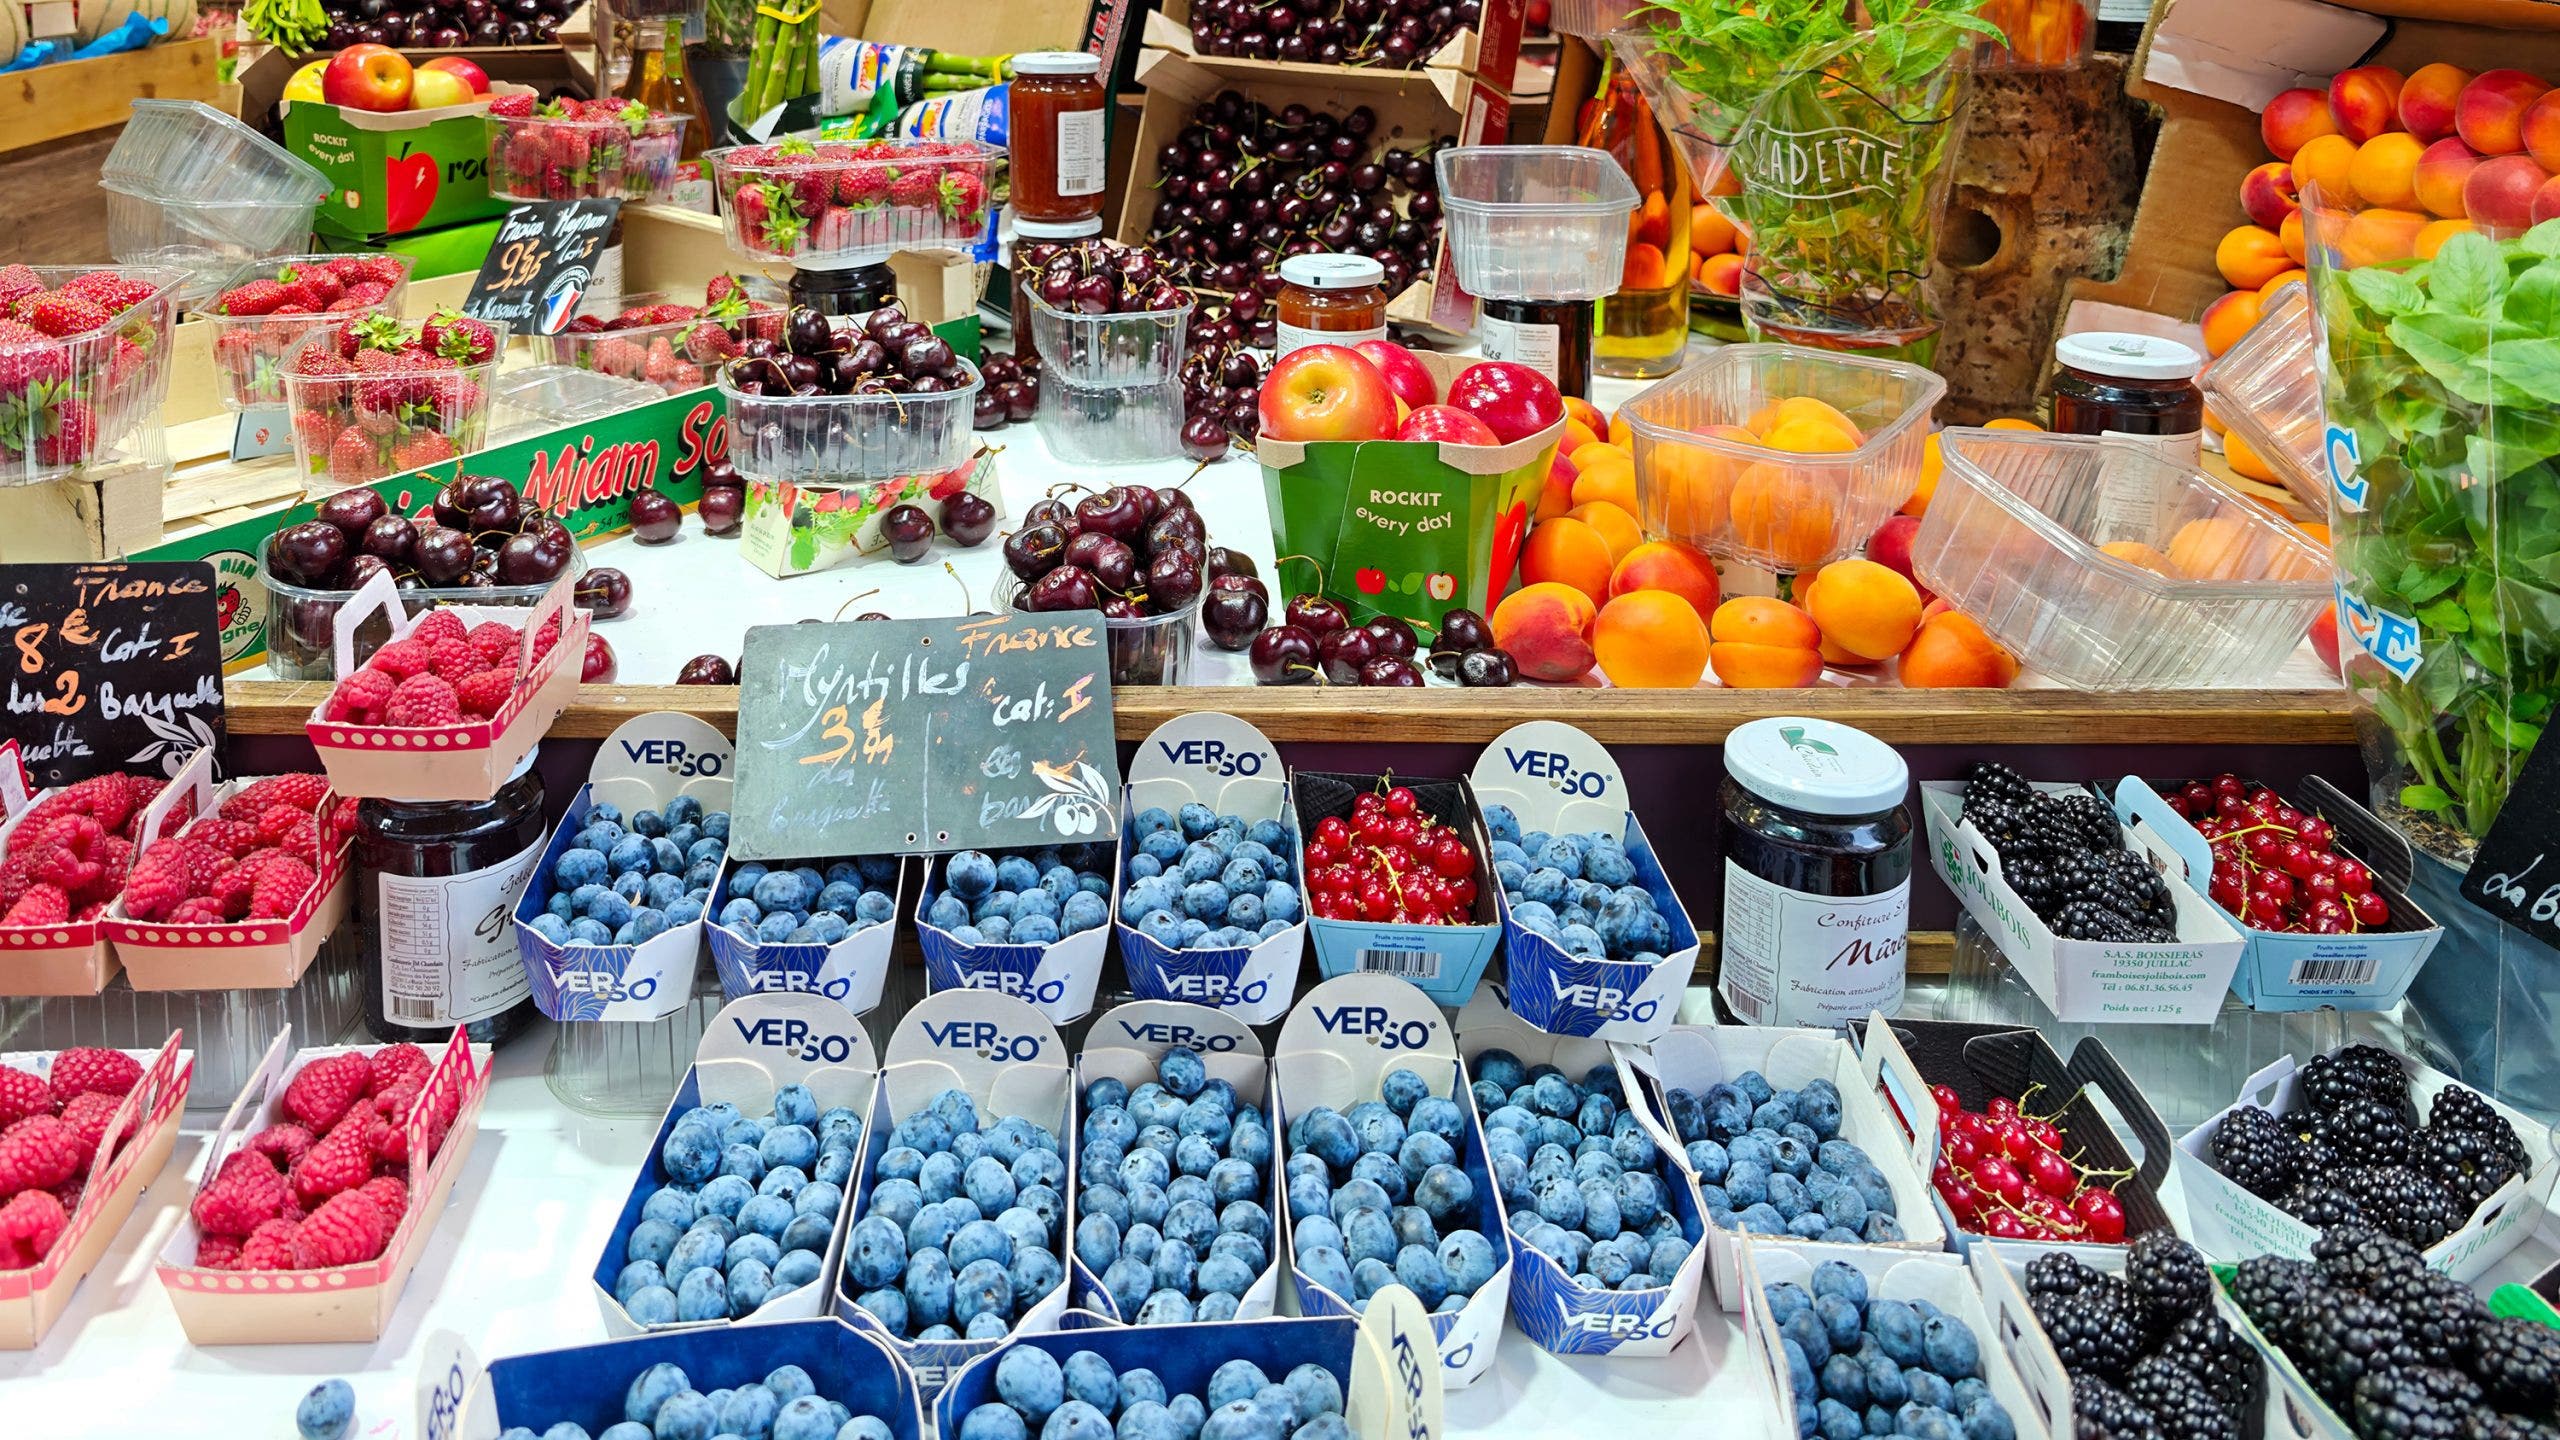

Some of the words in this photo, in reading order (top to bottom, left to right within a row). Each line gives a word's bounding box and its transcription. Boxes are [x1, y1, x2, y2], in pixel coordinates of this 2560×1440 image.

[308, 143, 335, 166] every
[337, 151, 355, 164] day
[313, 133, 347, 147] ROCKIT
[522, 435, 661, 518] Miam
[1370, 489, 1442, 506] ROCKIT
[1355, 507, 1410, 536] every
[1416, 511, 1452, 532] day
[15, 623, 49, 674] 8
[43, 670, 87, 716] 2
[620, 740, 723, 777] VERSO
[1159, 741, 1262, 777] VERSO
[1504, 747, 1606, 798] VERSO
[1817, 912, 1890, 930] Confiture
[1966, 865, 2031, 950] JOLIBOIS
[1374, 933, 1391, 941] Fruits
[2103, 950, 2133, 958] S.A.S.
[2136, 951, 2203, 959] BOISSIERAS
[545, 960, 657, 1002] VERSO
[2091, 970, 2206, 981] framboisesjolibois.com
[2145, 960, 2193, 969] JUILLAC
[1156, 965, 1267, 1006] VERSO
[1549, 968, 1658, 1022] VERSO
[1791, 979, 1846, 996] Fabrication
[1849, 982, 1887, 996] artisanale
[2125, 983, 2193, 992] 06.81.36.56.45
[2103, 1003, 2130, 1012] Poids
[733, 1017, 850, 1062] VERSO
[921, 1020, 1040, 1062] VERSO
[1119, 1020, 1236, 1052] VERSO
[1311, 1006, 1429, 1050] VERSO
[1554, 1292, 1677, 1341] VERSO
